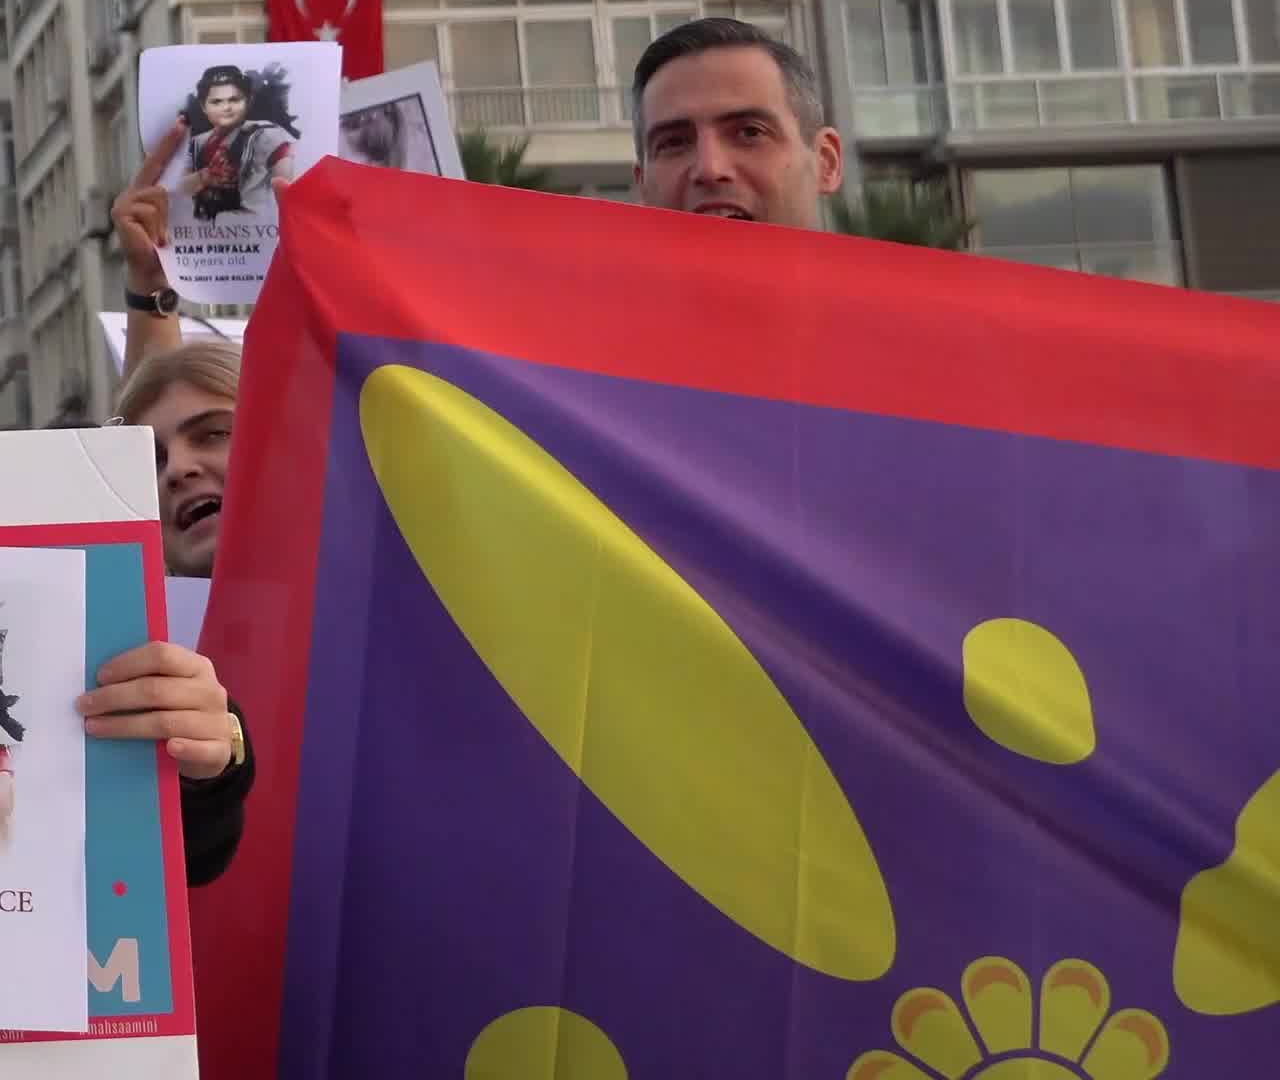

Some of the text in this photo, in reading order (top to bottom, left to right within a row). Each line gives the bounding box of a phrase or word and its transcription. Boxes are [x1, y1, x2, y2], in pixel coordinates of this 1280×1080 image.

[174, 226, 193, 239] BE
[175, 244, 260, 254] KIAN PIRFALAK
[176, 255, 247, 270] 10 years old
[80, 1016, 158, 1035] mahsaamini
